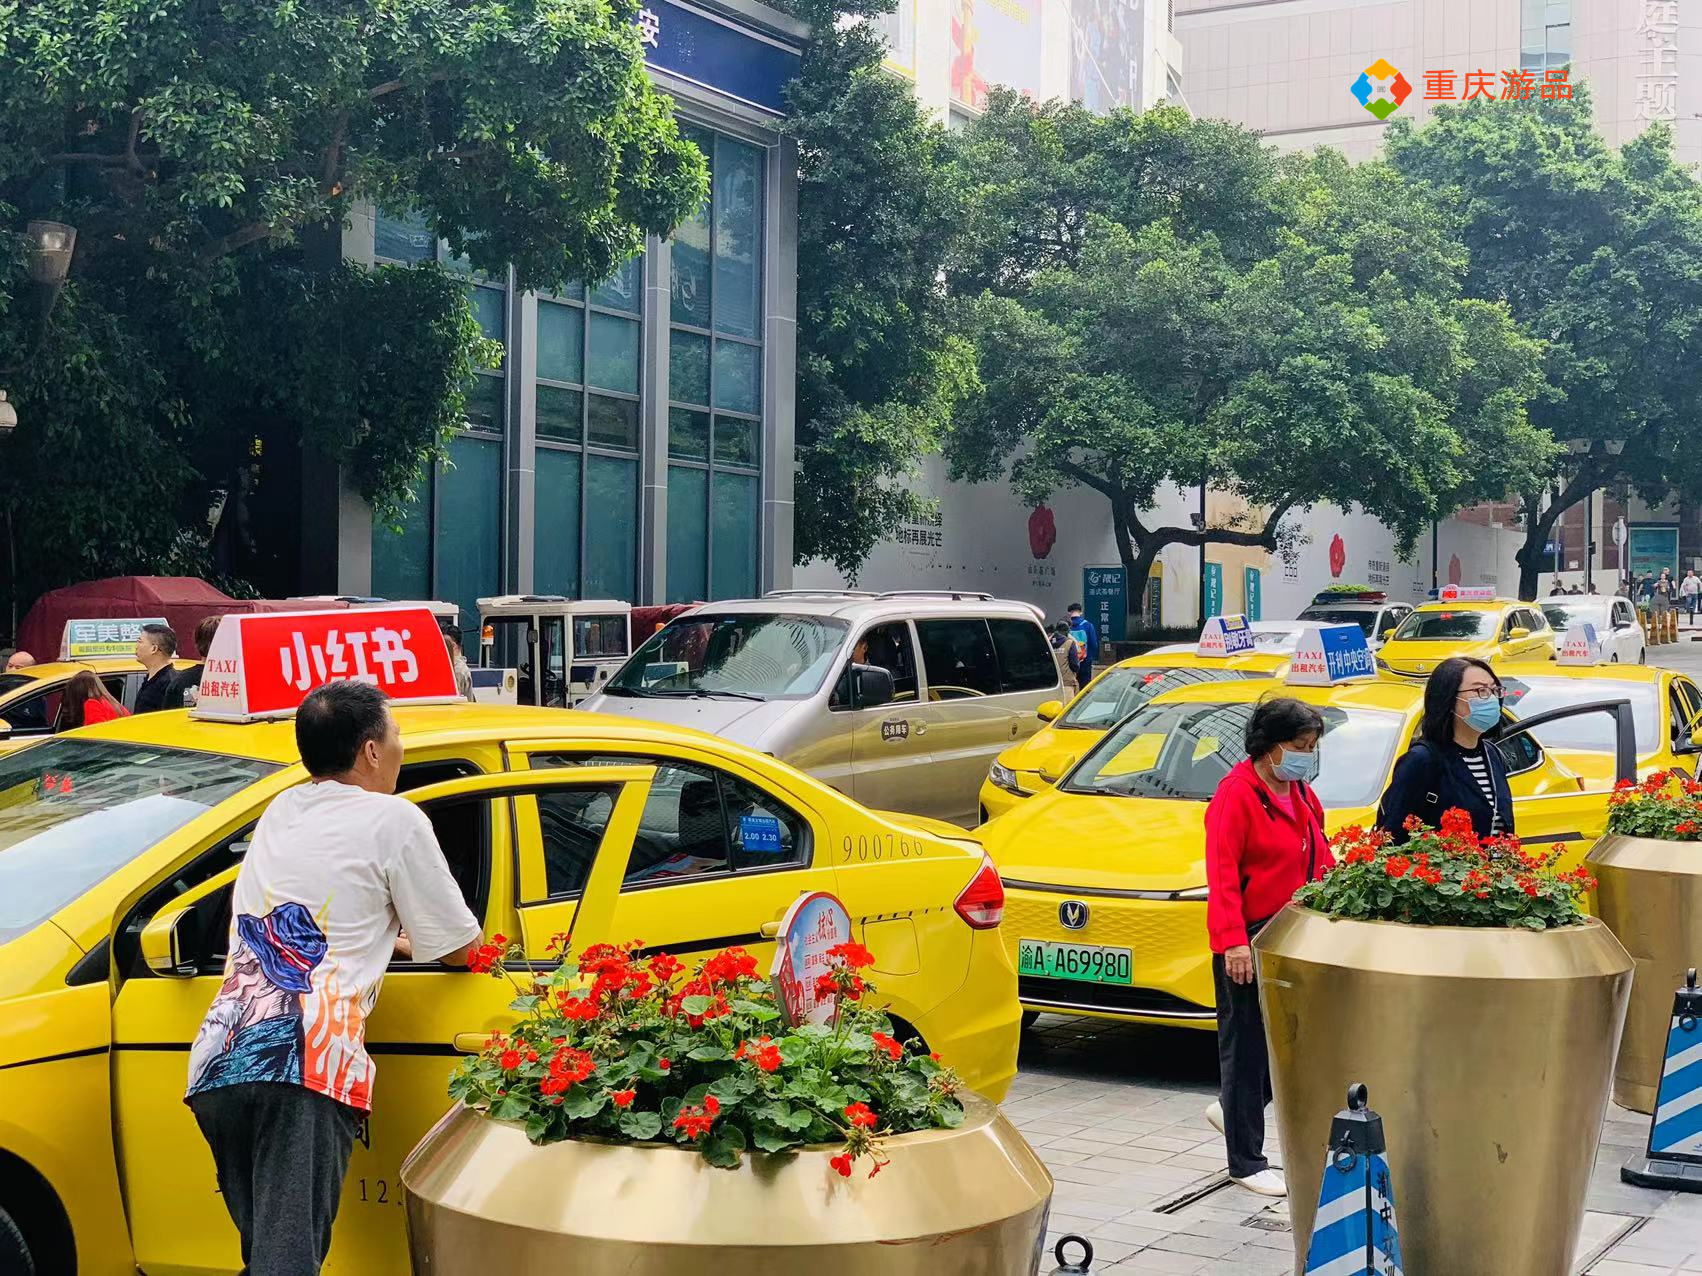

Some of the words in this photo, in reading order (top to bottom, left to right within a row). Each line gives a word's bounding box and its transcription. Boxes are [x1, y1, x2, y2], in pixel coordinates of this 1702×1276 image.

[74, 622, 164, 643] 军美整
[279, 626, 420, 691] 小红书
[1297, 651, 1323, 660] TAXI
[208, 659, 237, 674] TAXI
[1291, 662, 1325, 673] 出租汽车
[201, 681, 239, 698] 出租汽车
[744, 832, 760, 841] 2.00
[761, 833, 777, 842] 2.30
[843, 834, 923, 863] 900766
[359, 1178, 402, 1206] 12
